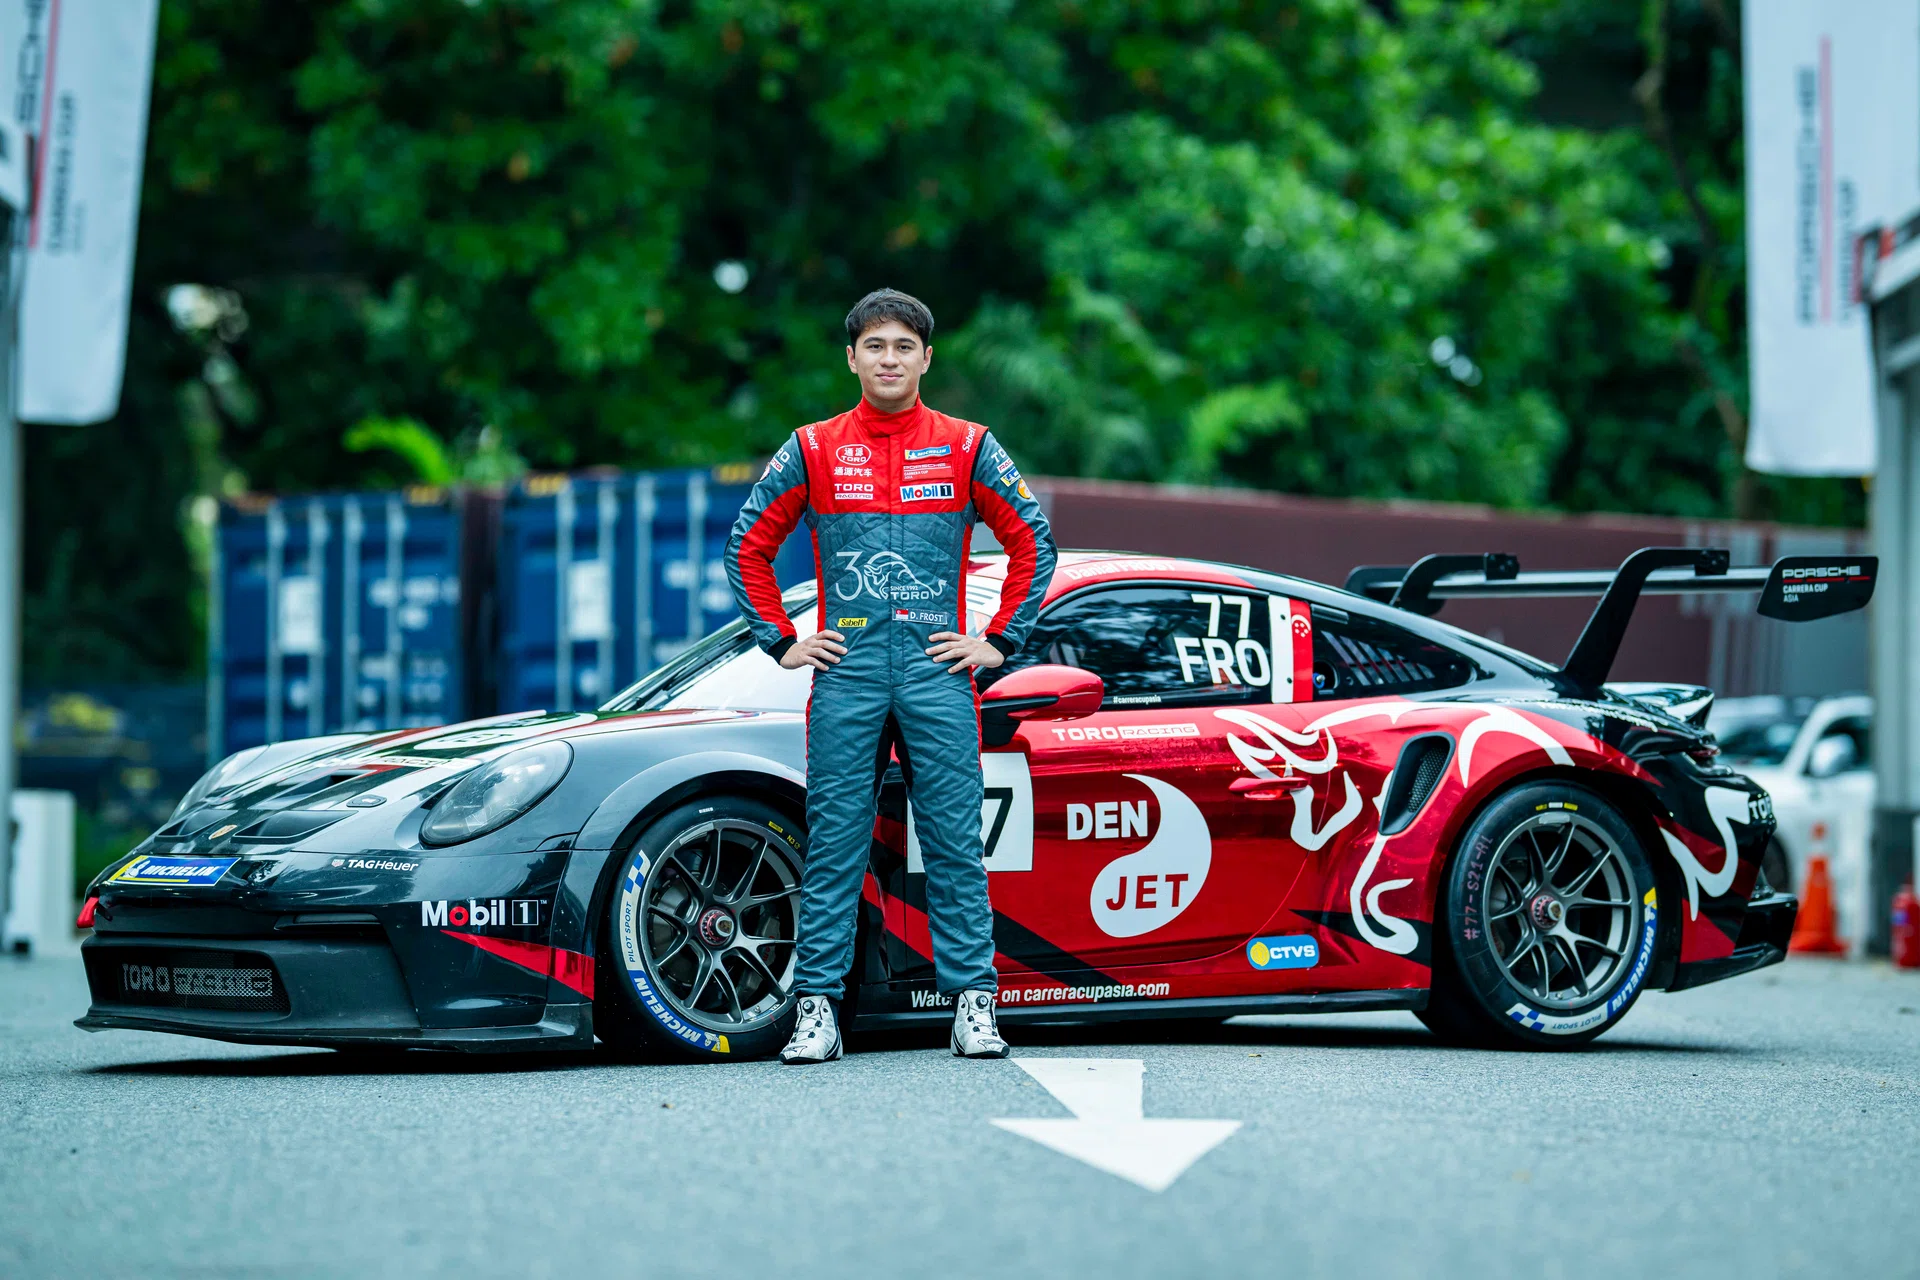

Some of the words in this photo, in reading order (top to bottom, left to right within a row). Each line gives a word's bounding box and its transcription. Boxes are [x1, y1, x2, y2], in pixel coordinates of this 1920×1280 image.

[806, 426, 819, 450] Sabelt
[962, 425, 976, 453] Sabelt
[917, 448, 947, 457] MICHELIN
[991, 448, 1007, 463] TO
[834, 467, 873, 477] 通源汽车
[834, 484, 874, 492] TORO
[902, 485, 938, 500] Mobil
[1064, 562, 1120, 580] Danial
[1782, 566, 1860, 578] PORSCHE
[890, 591, 930, 600] TORO
[1783, 584, 1814, 593] CARRERA
[1814, 583, 1829, 592] CUP
[1783, 594, 1799, 602] ASIA
[841, 618, 864, 627] Sabelt
[910, 612, 919, 620] D.
[920, 613, 944, 622] FROST
[1191, 594, 1250, 638] 77
[1174, 637, 1271, 686] FRO
[1113, 694, 1161, 705] #carreracupasia
[1051, 727, 1119, 741] TORO
[1122, 726, 1196, 736] RACING
[983, 787, 1014, 857] 7
[1066, 800, 1148, 840] DEN
[141, 865, 220, 877] MICHELIN
[1105, 873, 1189, 911] JET
[421, 900, 506, 927] Mobil
[624, 901, 632, 934] SPORT
[624, 935, 636, 963] PILOT
[1269, 945, 1316, 959] CTVS
[1612, 926, 1655, 1012] MICHELIN
[122, 963, 170, 992] TORO
[911, 990, 953, 1007] Watc
[1002, 991, 1020, 1003] on
[1023, 982, 1170, 1003] carreracupasia.com
[633, 977, 702, 1043] MICHELIN
[1580, 1014, 1602, 1025] PILOT
